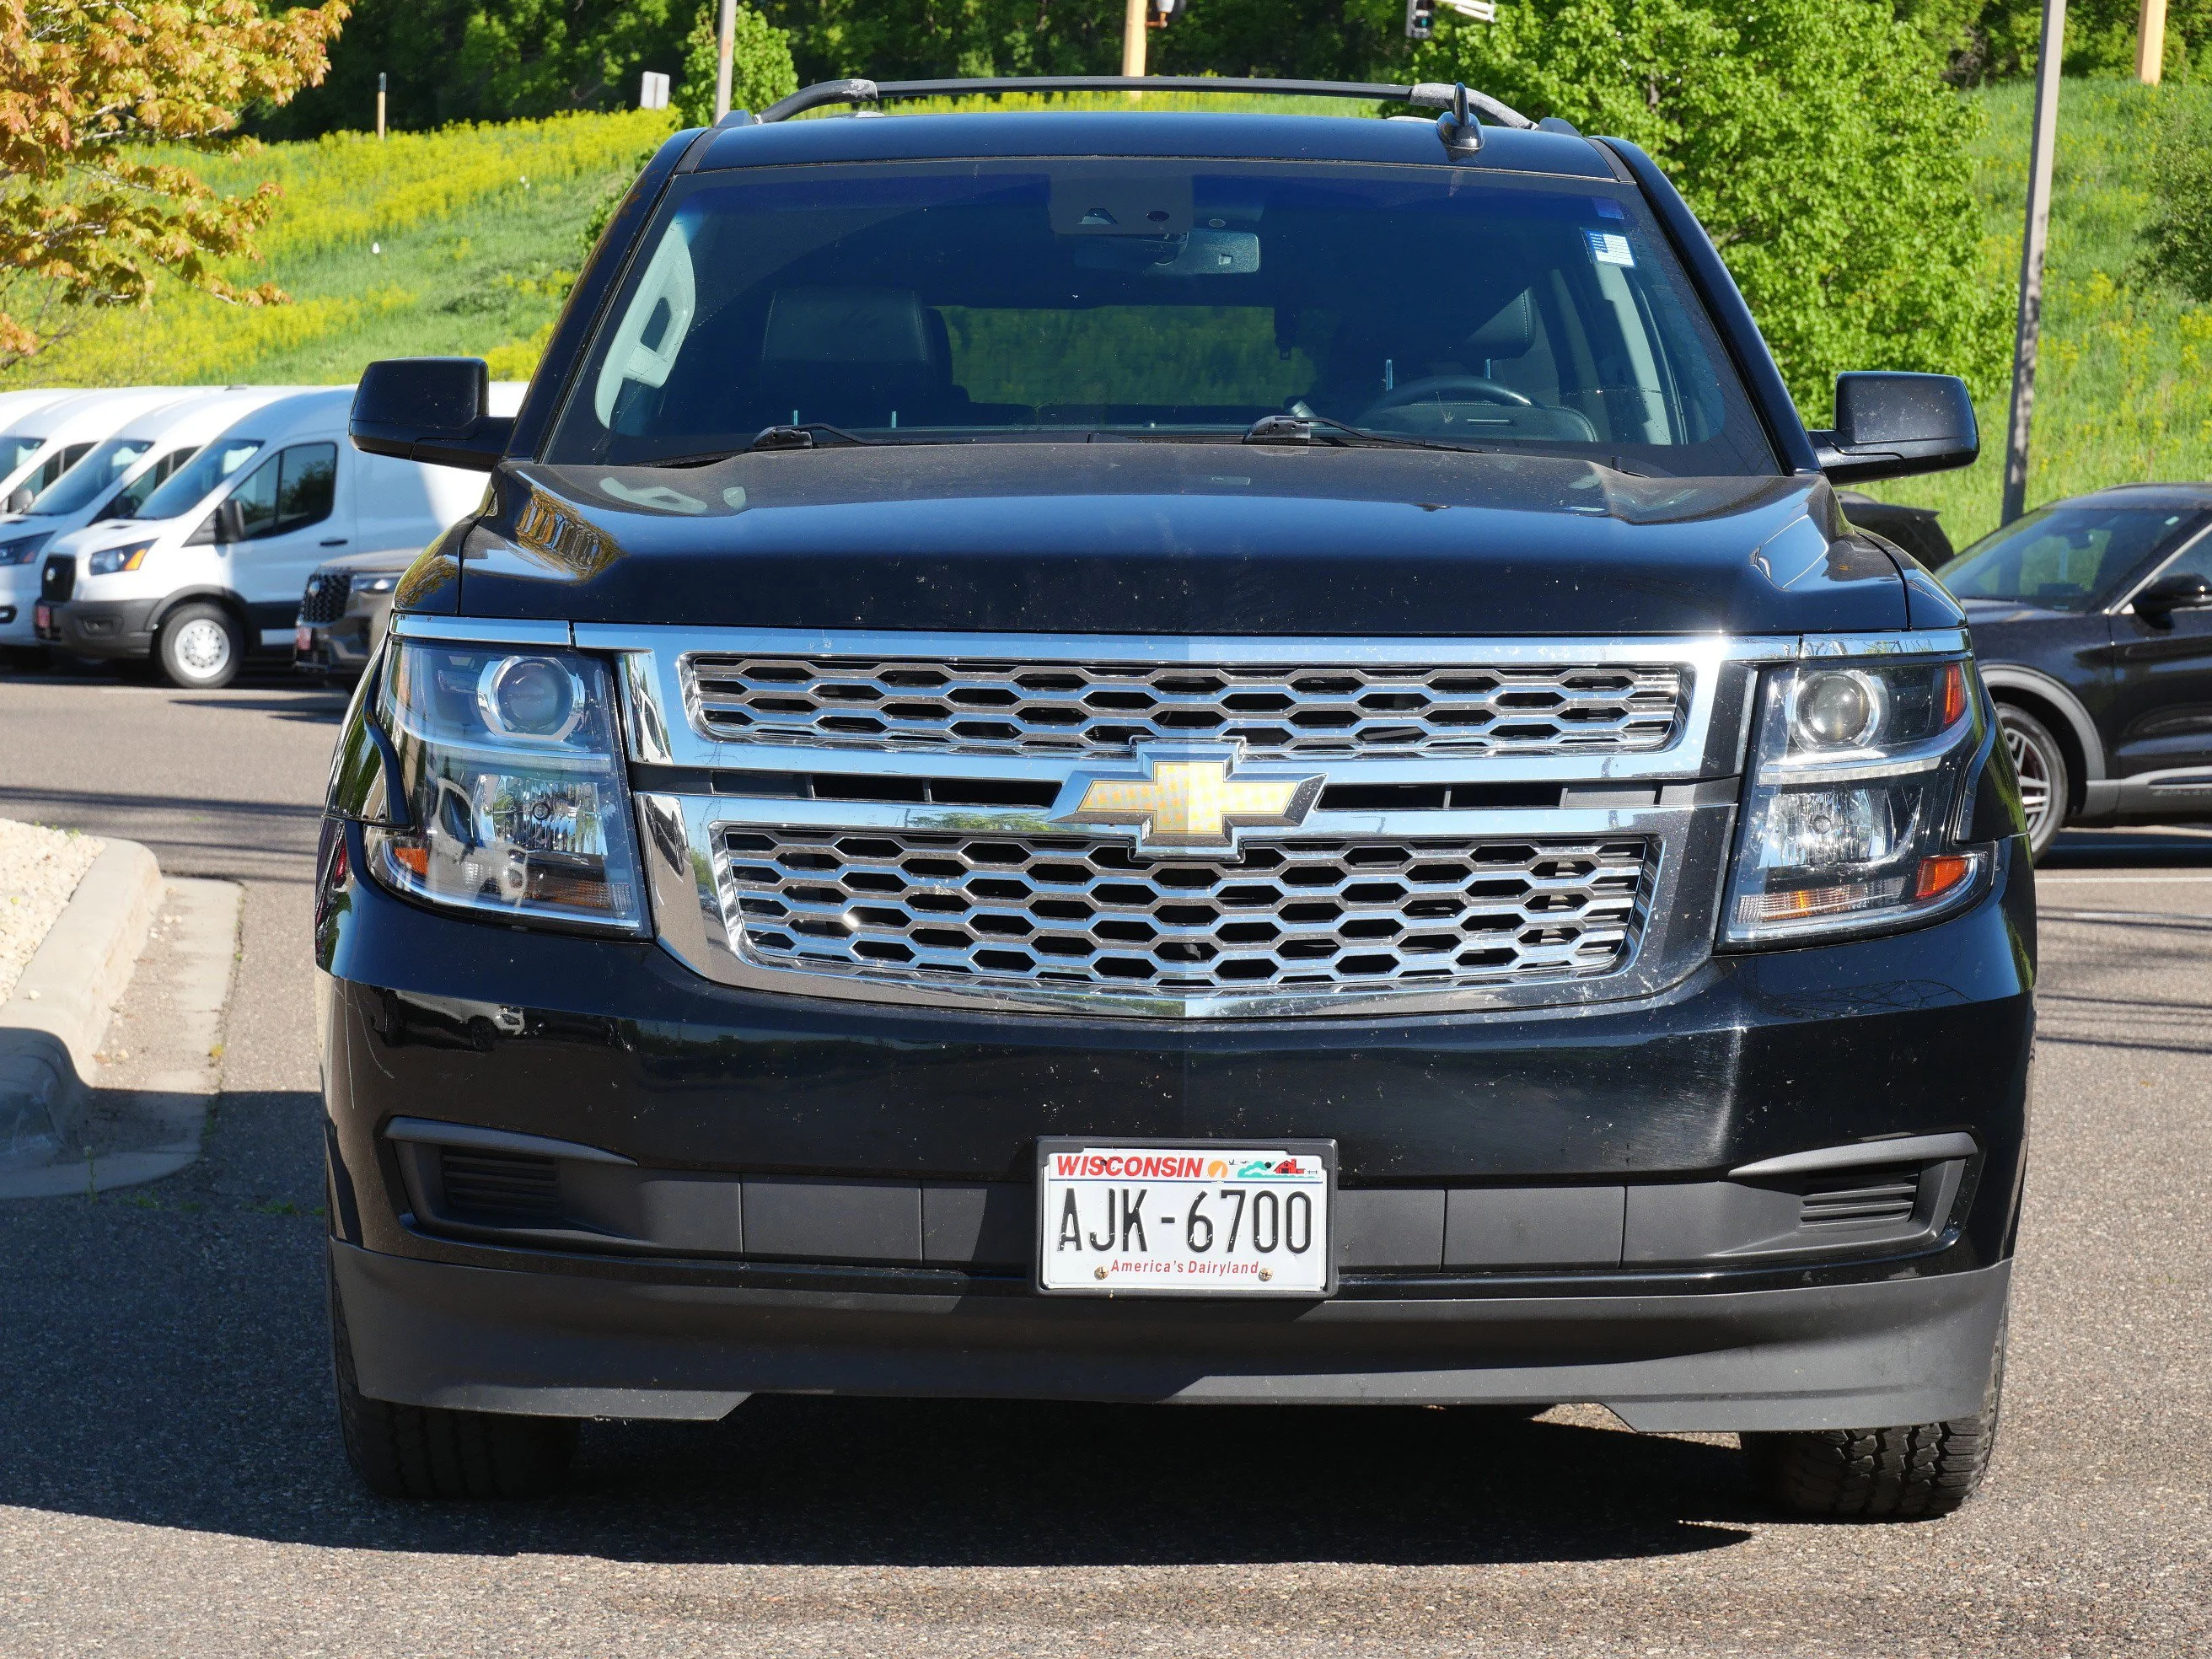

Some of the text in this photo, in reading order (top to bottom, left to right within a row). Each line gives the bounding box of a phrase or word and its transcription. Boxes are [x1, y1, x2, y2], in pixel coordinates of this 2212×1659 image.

[1057, 1156, 1204, 1178] WISCONSIN
[1057, 1187, 1312, 1254] AJK-6700
[1110, 1259, 1259, 1276] America's Dairyland
